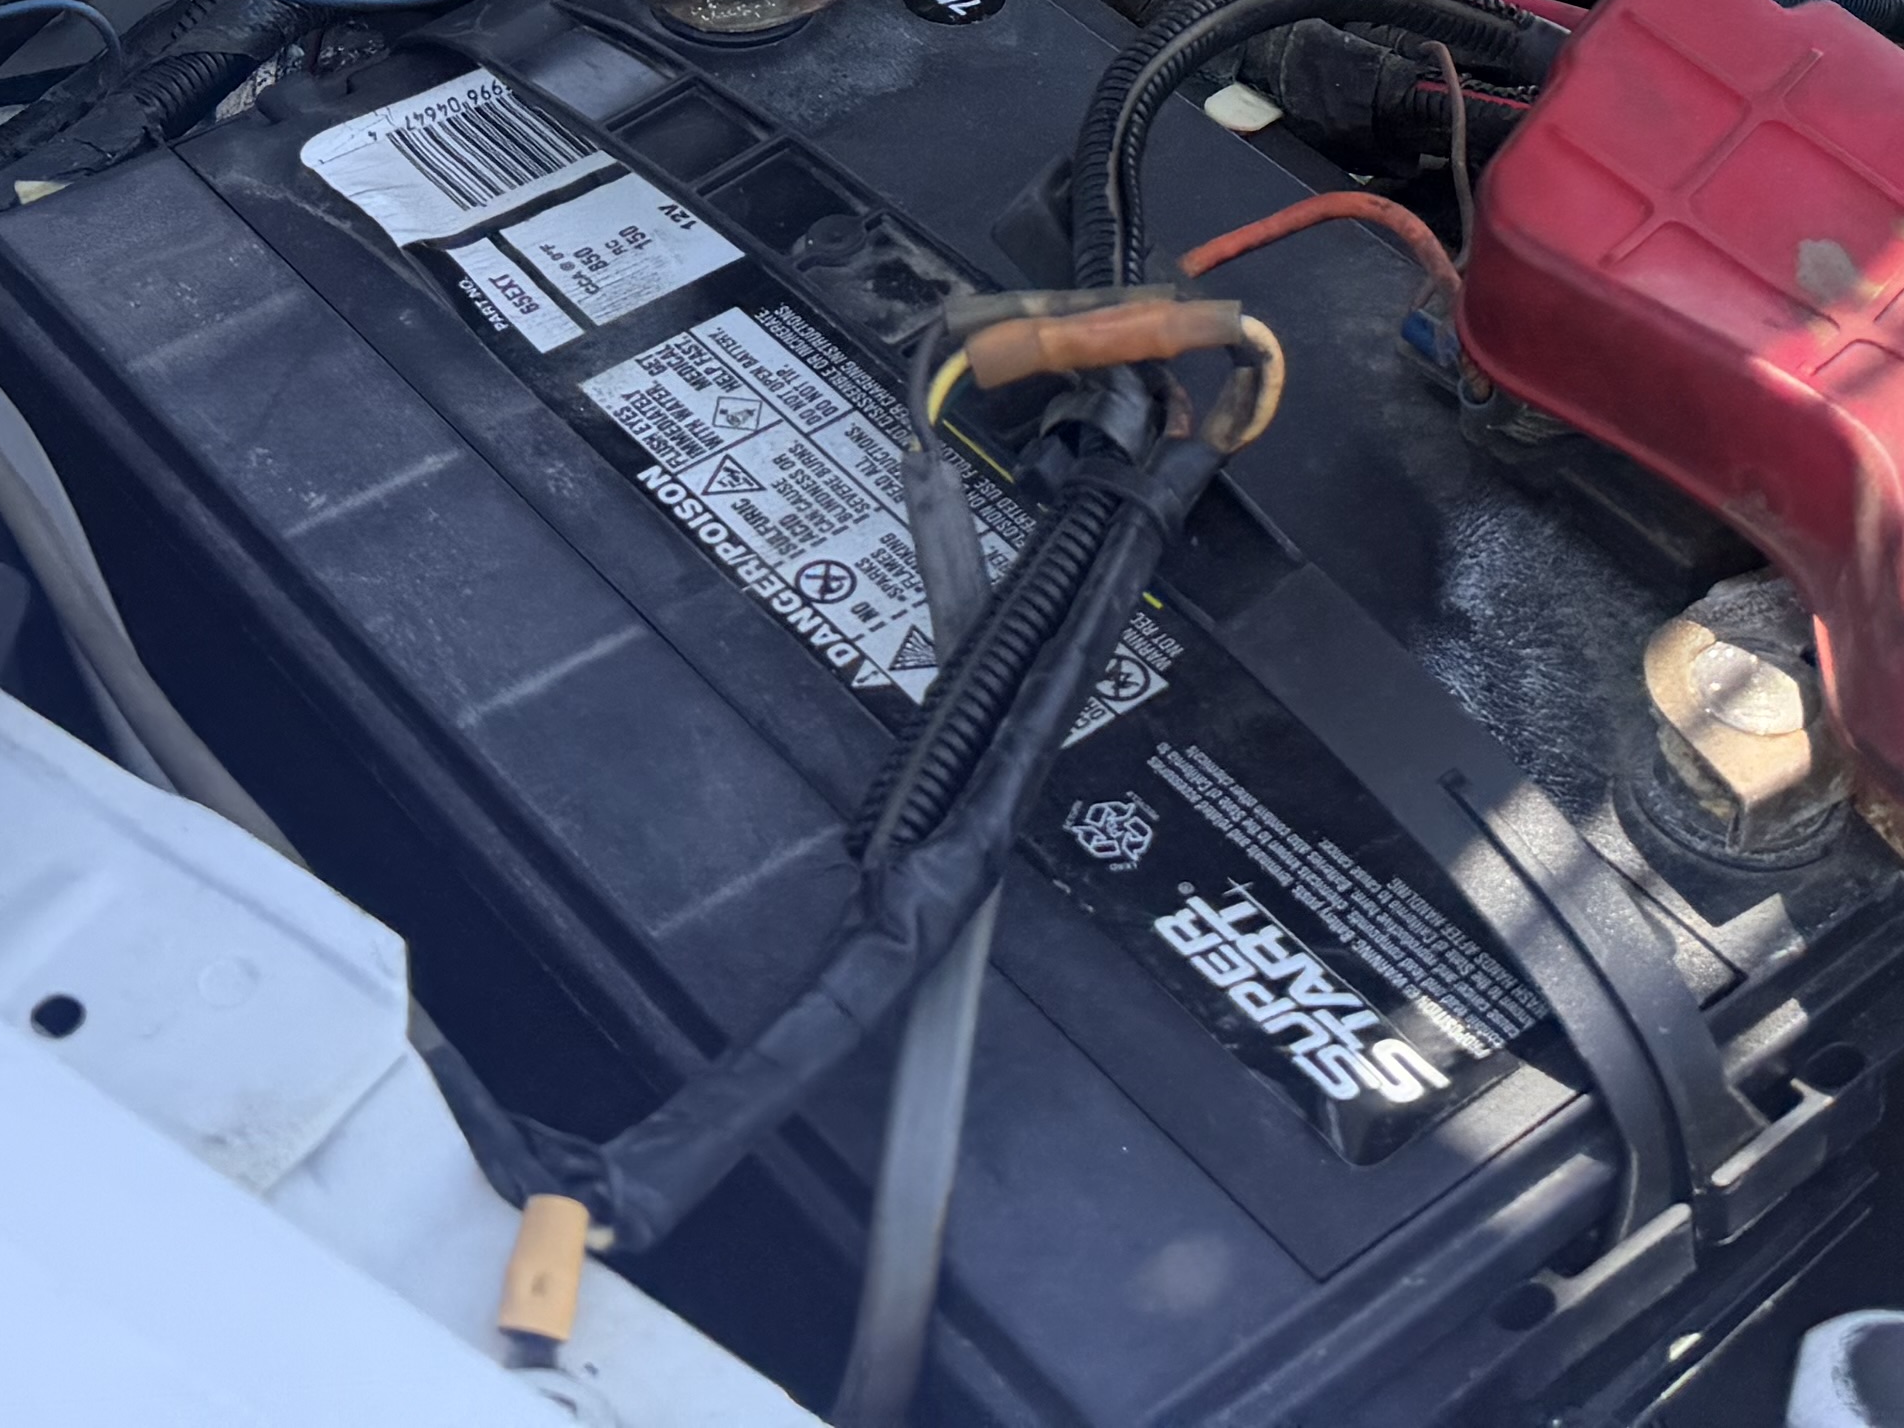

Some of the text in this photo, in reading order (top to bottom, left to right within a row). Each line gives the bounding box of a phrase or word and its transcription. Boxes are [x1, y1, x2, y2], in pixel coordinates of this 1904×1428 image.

[403, 95, 463, 130] 04647
[617, 223, 652, 250] 150
[656, 202, 698, 232] 12V
[572, 244, 609, 273] 850
[603, 237, 628, 256] RC
[455, 277, 511, 331] PART NO.
[486, 269, 541, 316] 65EXT
[569, 270, 601, 295] CCA
[633, 351, 668, 377] GET
[654, 343, 713, 392] MEDICAL
[672, 335, 743, 393] HELP FAST.
[706, 326, 823, 425] DO NOT OPEN BATTERY.
[771, 301, 899, 407] CHARGING INSTRUCTIONS.
[642, 381, 725, 449] WITH WATER.
[774, 364, 839, 416] DO NOT TIP.
[611, 404, 688, 468] FLUSH EYES
[620, 386, 707, 460] IMMEDIATELY
[771, 452, 854, 523] BLINDNESS OR
[785, 440, 872, 514] SEVERE BURNS.
[852, 457, 881, 478] ALL
[728, 496, 799, 556] SULFURIC
[769, 476, 836, 533] CAN CAUSE
[777, 513, 817, 544] ACID
[633, 463, 861, 667] DANGER/POISON
[853, 556, 904, 598] SPARKS
[869, 546, 921, 589] FLAMES
[848, 600, 880, 623] NO
[1150, 904, 1384, 1103] SUPER
[1184, 899, 1452, 1102] START
